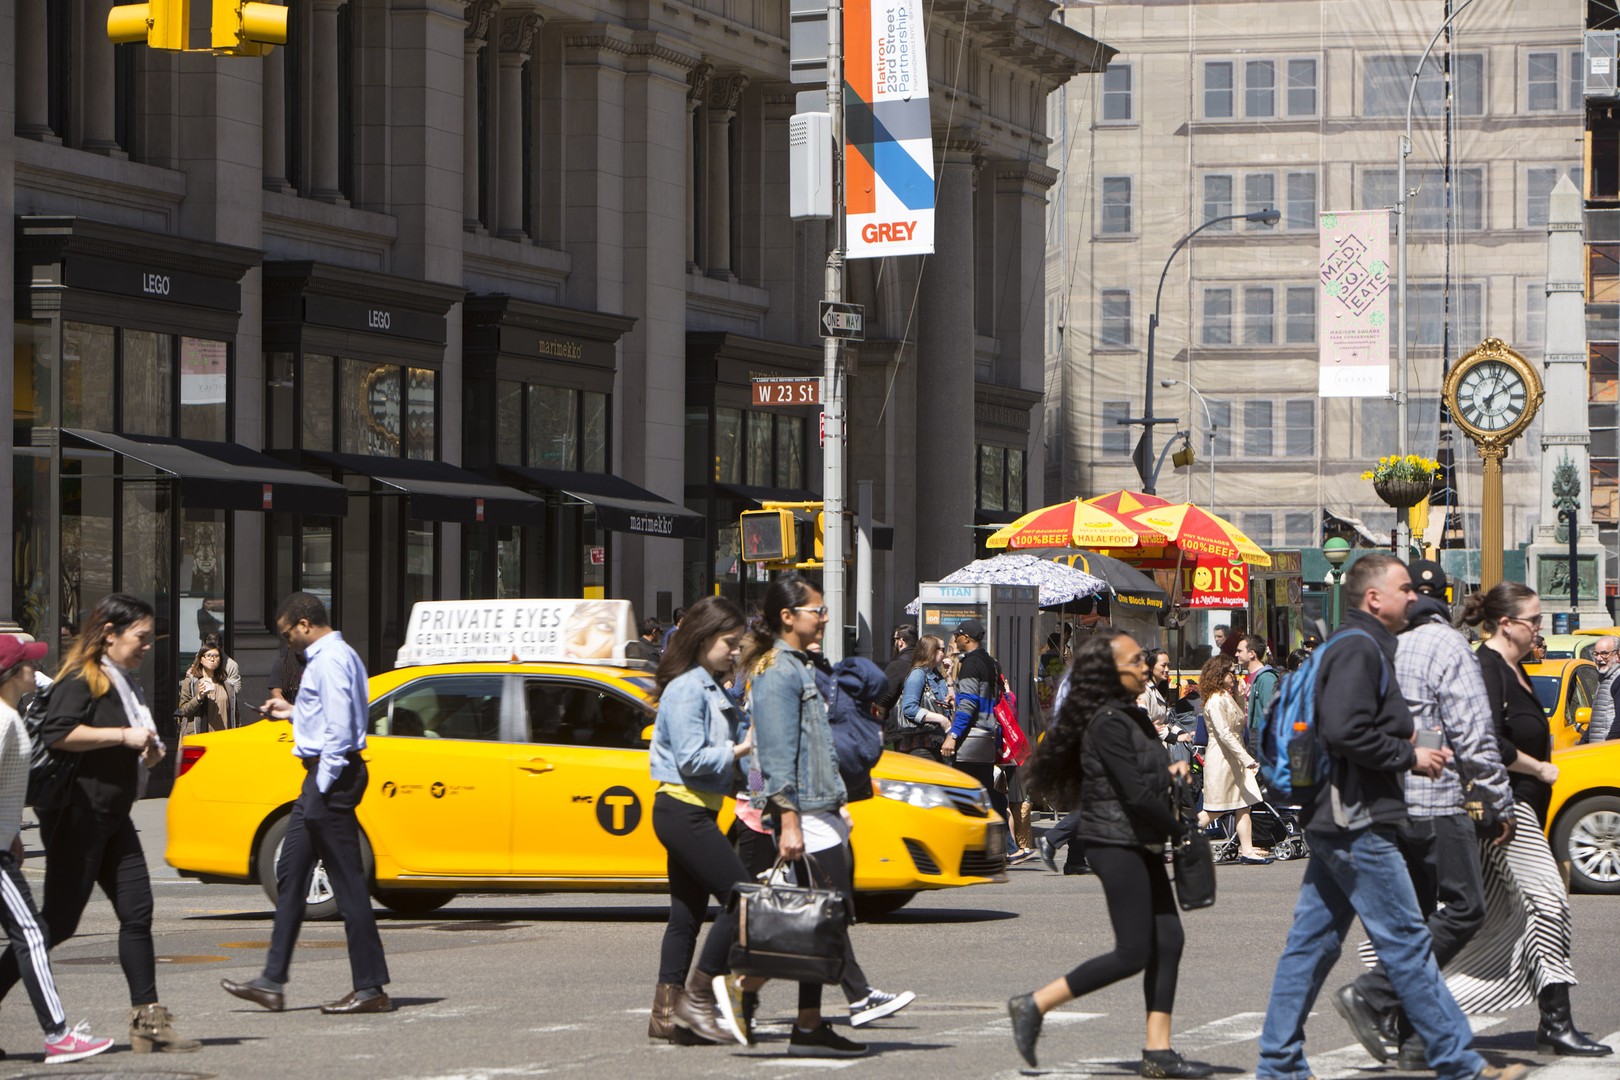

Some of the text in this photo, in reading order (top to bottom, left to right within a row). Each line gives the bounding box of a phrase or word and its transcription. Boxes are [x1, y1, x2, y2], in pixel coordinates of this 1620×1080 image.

[886, 8, 897, 92] 23rd Street
[896, 7, 910, 92] Partnership
[876, 37, 886, 94] Flatiron
[861, 221, 917, 243] GREY
[1321, 246, 1360, 281] MAD.
[143, 273, 170, 295] LEGO
[1350, 271, 1388, 309] EATS
[368, 310, 390, 329] LEGO
[827, 313, 860, 329] ONE WAY
[759, 384, 814, 402] W 23 St
[630, 515, 673, 534] marimekko
[1078, 534, 1134, 543] HALAL FOOD
[1182, 566, 1245, 593] IQI'S
[940, 586, 972, 597] TITAN
[1128, 595, 1146, 606] Block
[1146, 597, 1163, 609] Away
[419, 608, 561, 630] PRIVATE EYES
[927, 615, 939, 623] ion
[415, 631, 558, 645] GENTLEMEN'S CLUB
[604, 795, 634, 830] T
